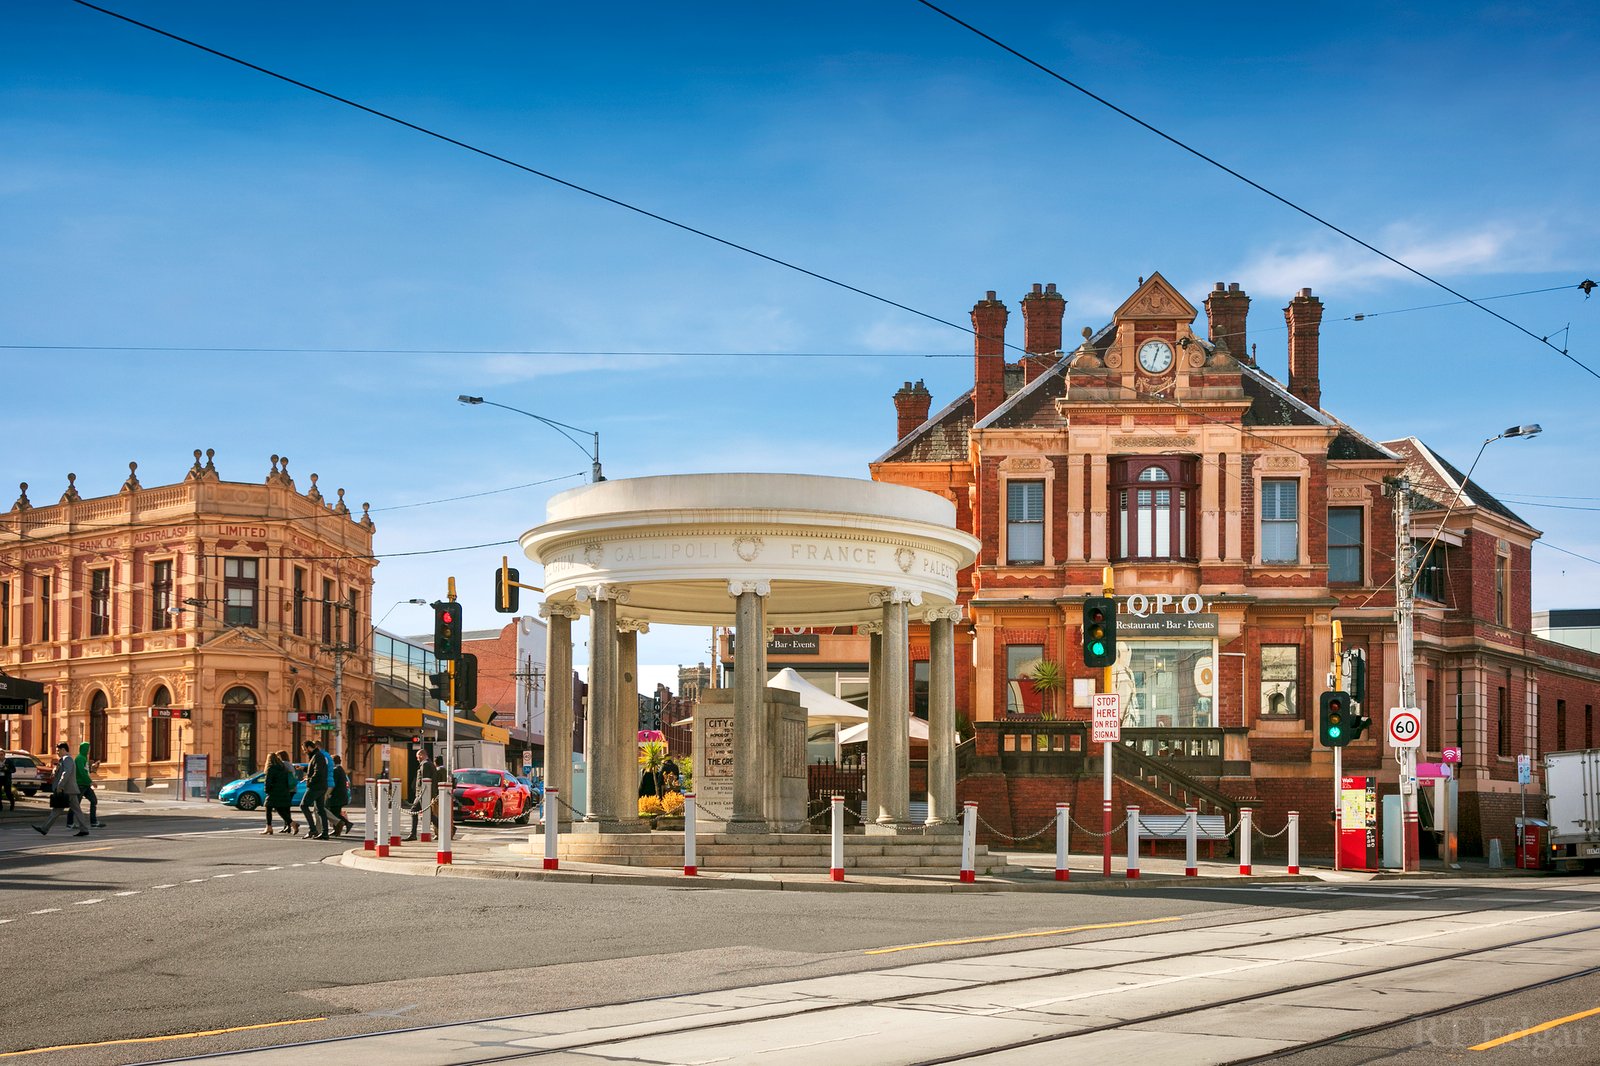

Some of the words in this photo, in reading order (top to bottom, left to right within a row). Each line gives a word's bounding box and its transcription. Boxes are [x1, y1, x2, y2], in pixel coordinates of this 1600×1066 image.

[218, 525, 266, 538] LIMITED
[25, 545, 63, 559] NATIONAL
[79, 539, 103, 551] BANK
[106, 536, 118, 547] OF
[615, 542, 718, 562] GALLIPOLI
[790, 543, 876, 564] FRANCE
[1116, 620, 1160, 629] Restaurant
[1166, 620, 1182, 629] Bar
[1187, 620, 1215, 629] Events
[1096, 697, 1117, 706] STOP
[1096, 709, 1117, 718] HERE
[708, 719, 729, 728] CITY
[1094, 720, 1104, 728] ON
[1105, 720, 1118, 728] RED
[1395, 720, 1415, 733] 60
[1094, 731, 1118, 739] SIGNAL
[707, 758, 721, 766] THE
